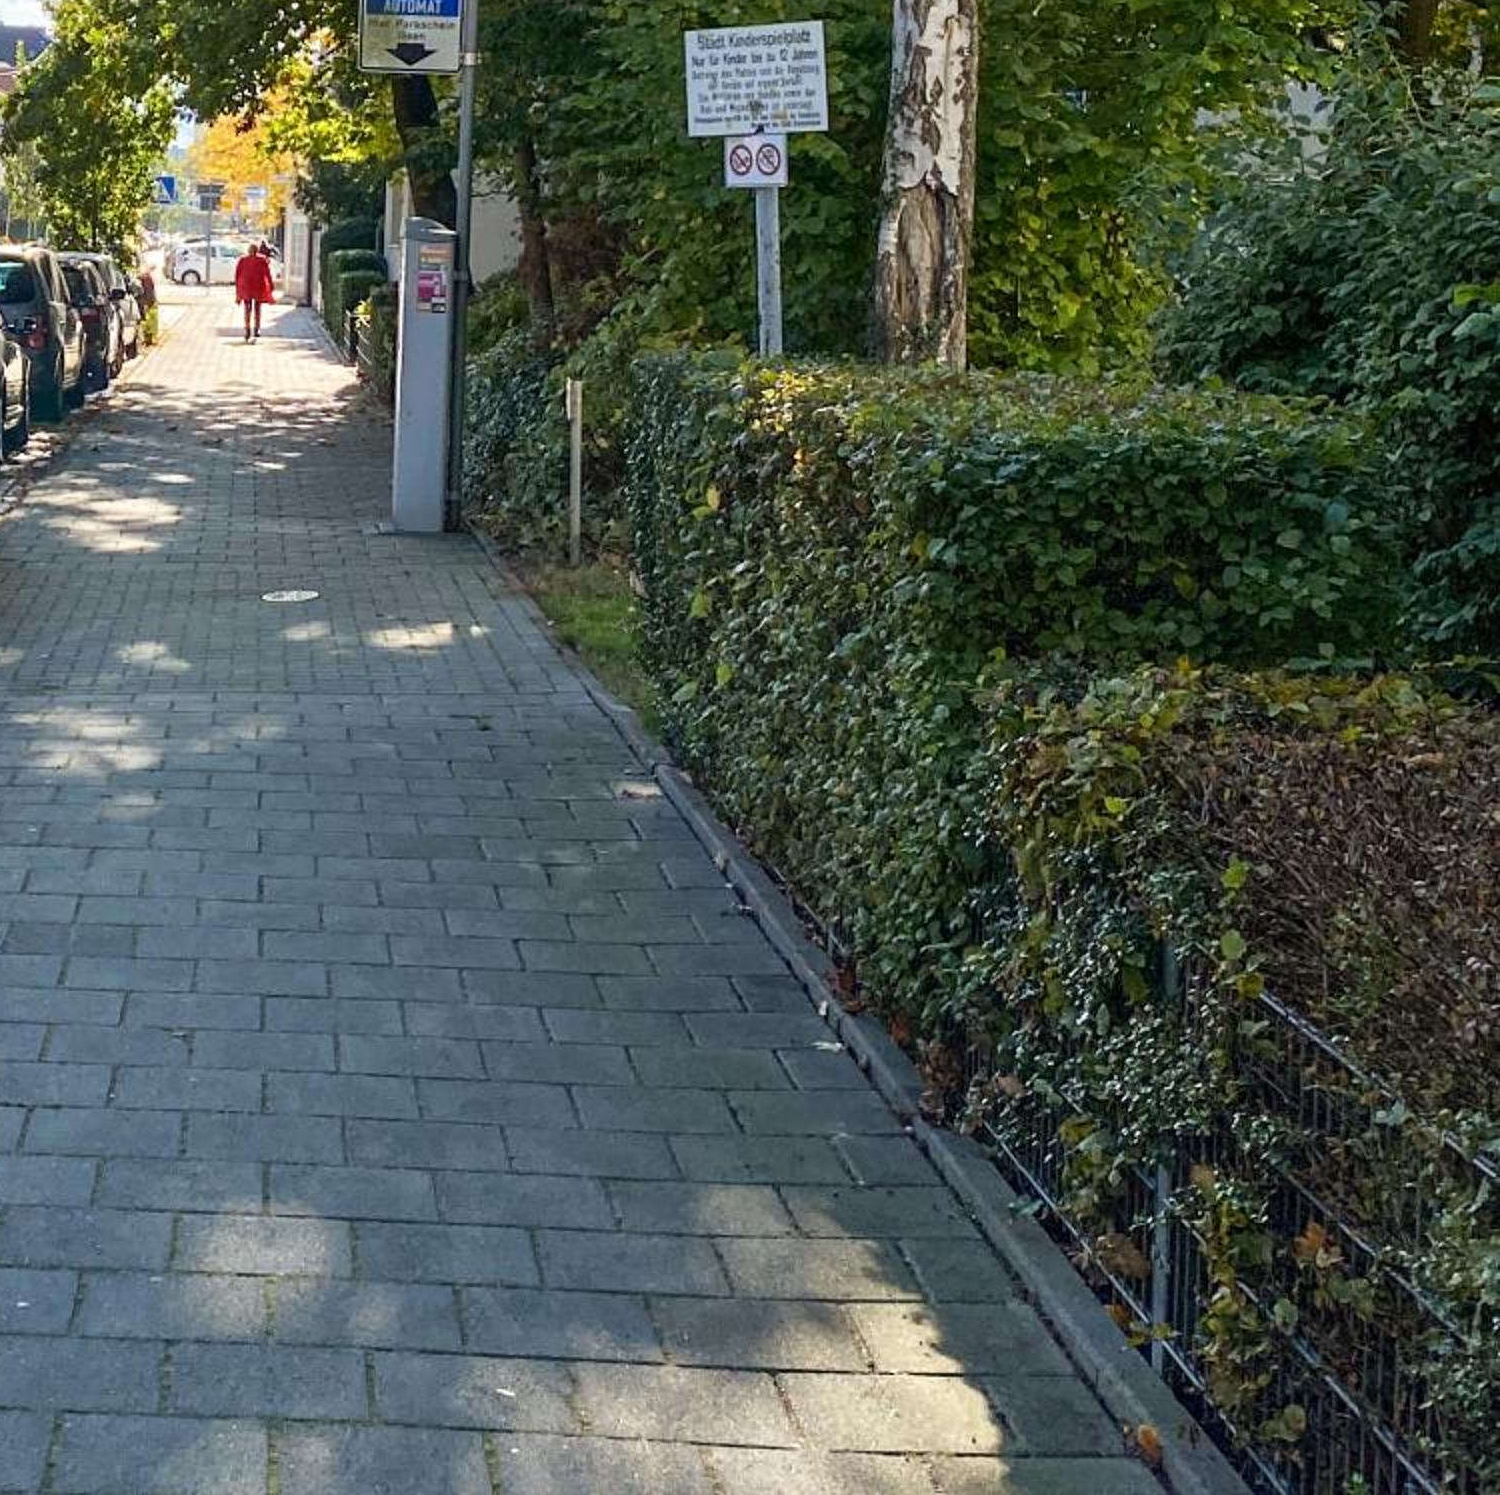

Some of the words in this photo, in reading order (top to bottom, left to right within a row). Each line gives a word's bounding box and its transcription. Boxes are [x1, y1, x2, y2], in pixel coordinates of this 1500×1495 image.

[730, 29, 811, 48] Kinderspielplatz
[692, 57, 704, 66] Nur
[724, 54, 747, 65] Kinder
[780, 49, 788, 61] 12
